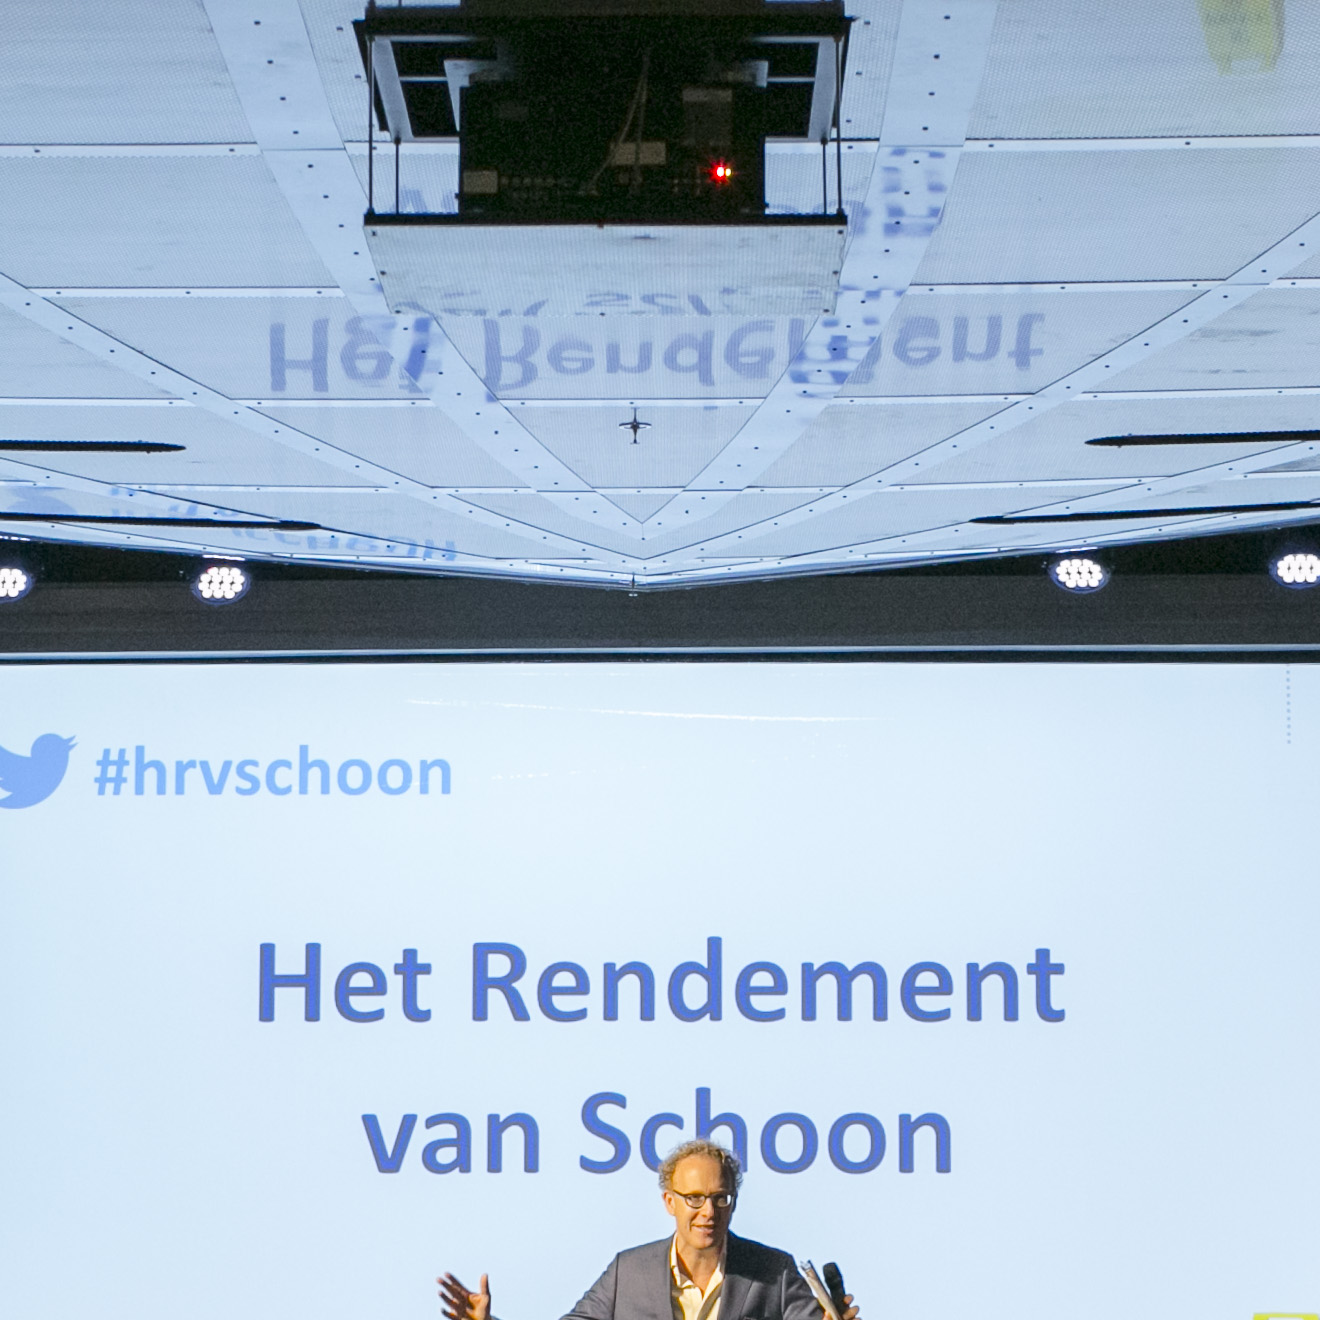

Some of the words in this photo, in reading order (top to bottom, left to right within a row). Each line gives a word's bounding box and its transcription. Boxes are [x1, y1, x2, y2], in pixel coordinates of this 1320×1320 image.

[93, 744, 452, 796] #hrvschoon
[258, 942, 433, 1024] Het
[471, 935, 1066, 1024] Rendement
[361, 1111, 540, 1175] van
[579, 1086, 952, 1175] Schoon
